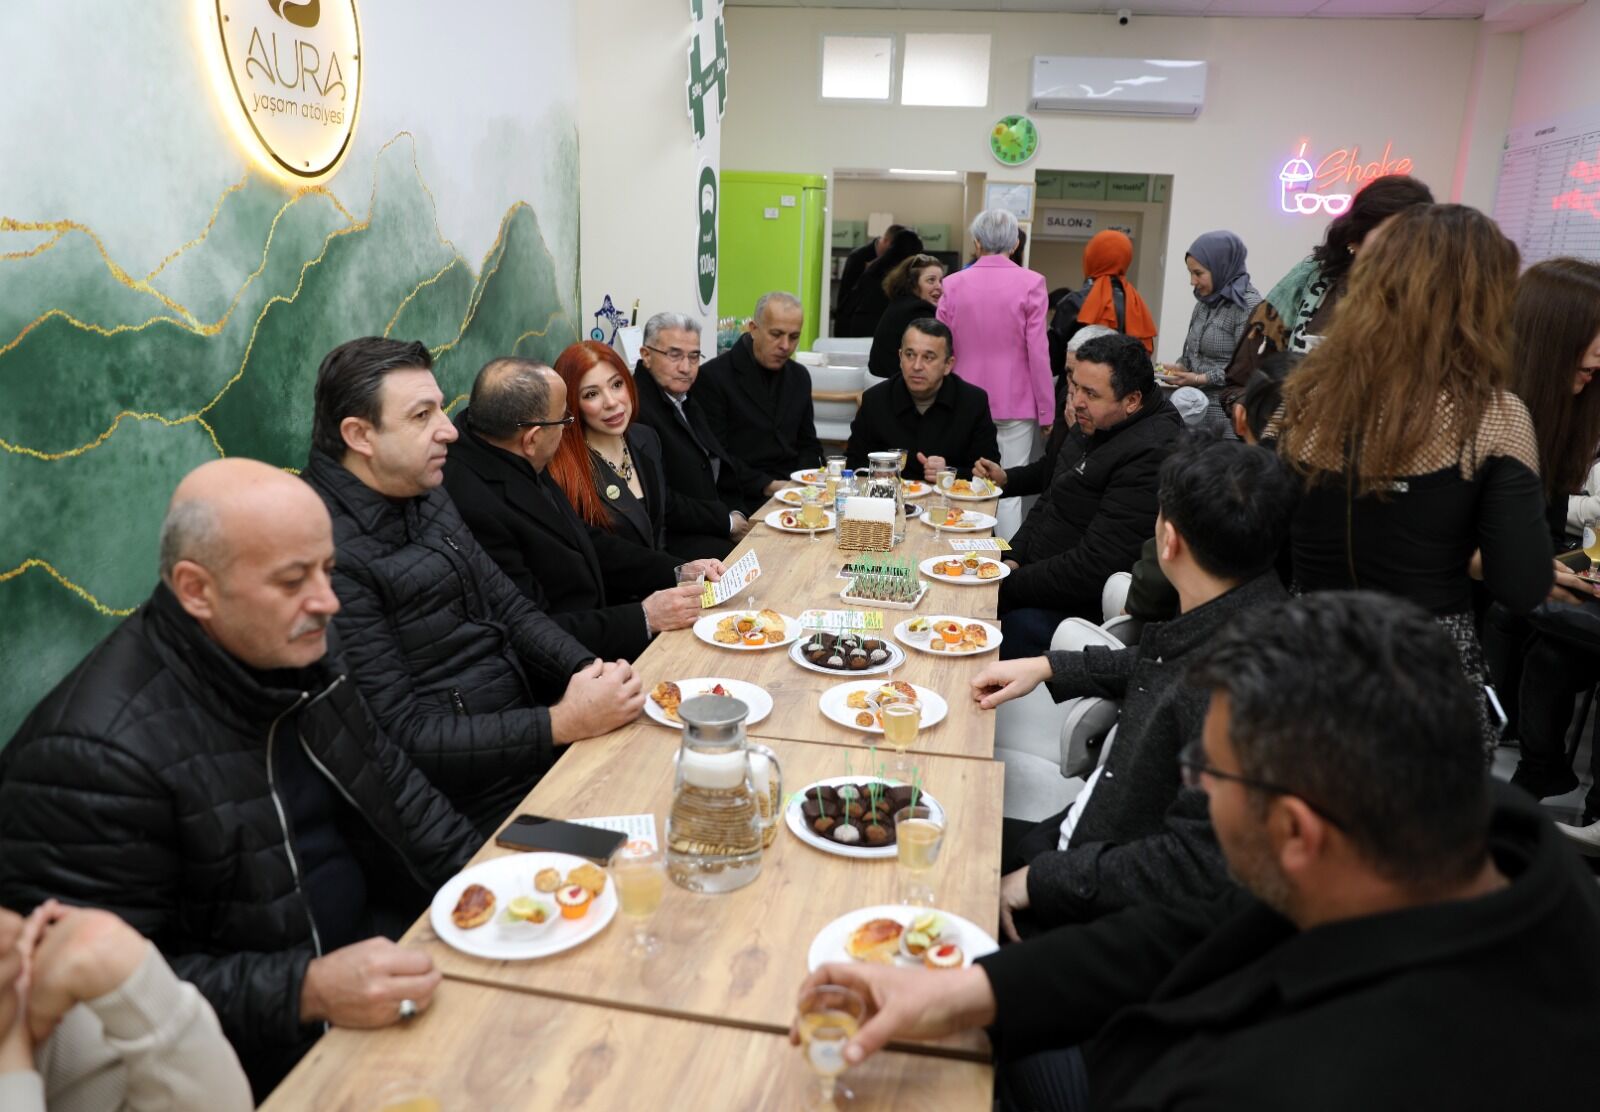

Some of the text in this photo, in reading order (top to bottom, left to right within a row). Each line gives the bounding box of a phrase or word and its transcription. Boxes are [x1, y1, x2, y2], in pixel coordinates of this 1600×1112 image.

[245, 26, 347, 101] AURA
[252, 92, 298, 117] yaşam
[1314, 141, 1413, 191] Shake
[1047, 216, 1092, 228] SALON-2
